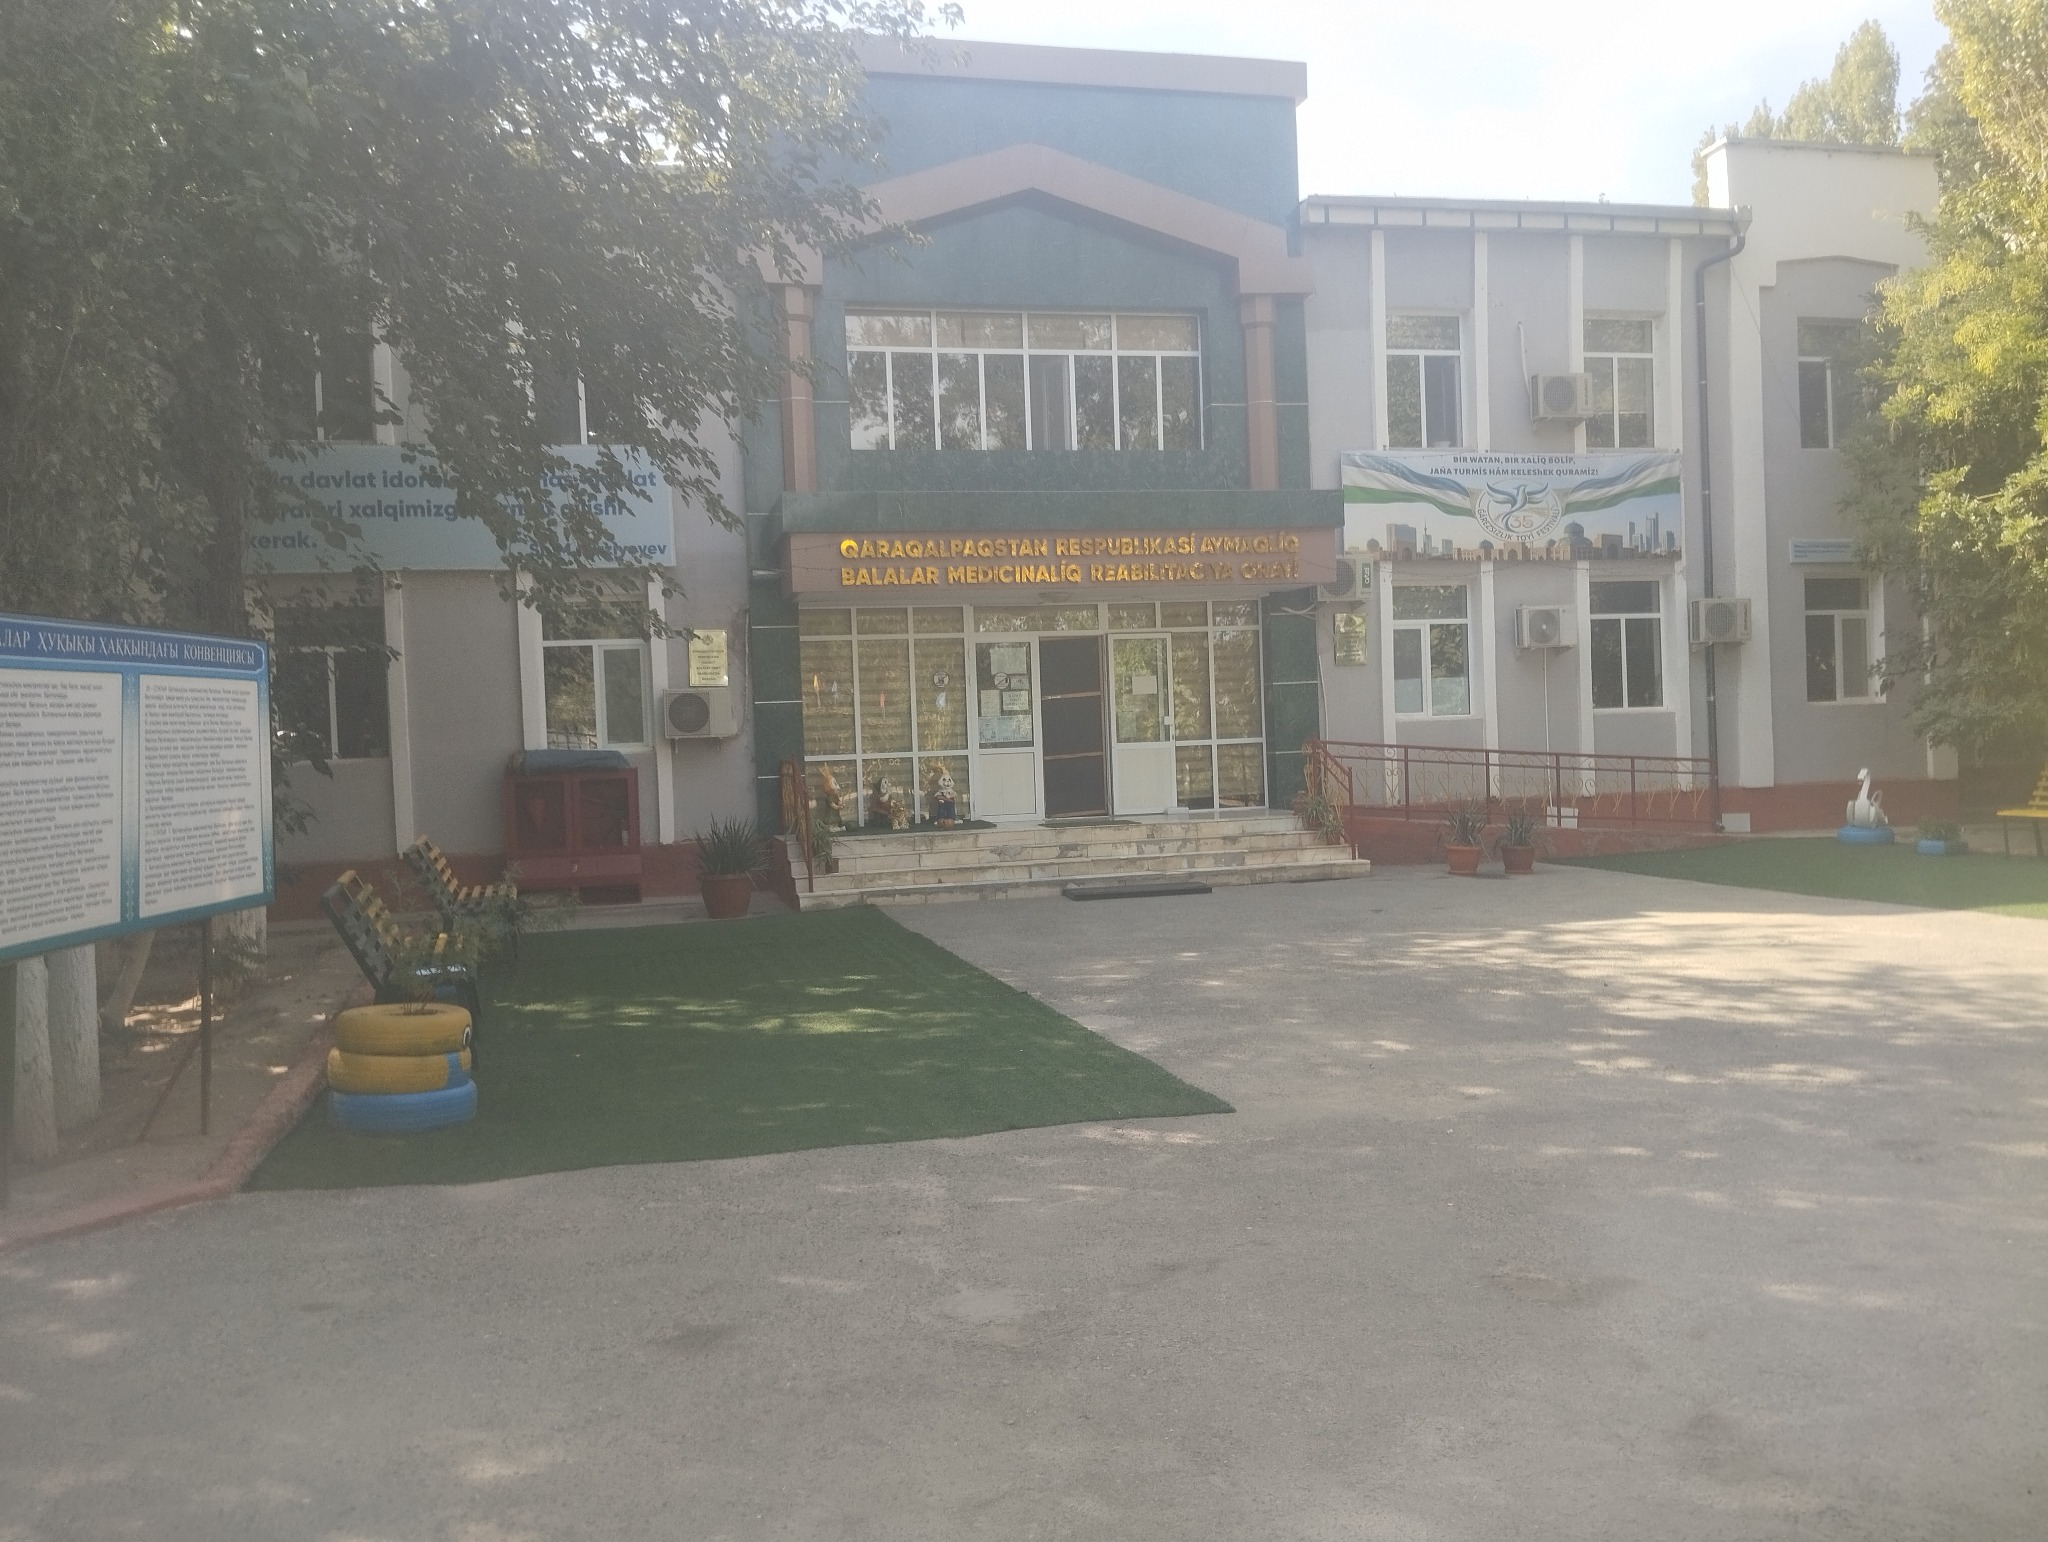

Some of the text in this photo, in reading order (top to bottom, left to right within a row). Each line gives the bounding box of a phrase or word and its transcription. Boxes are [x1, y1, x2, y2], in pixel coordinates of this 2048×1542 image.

[1452, 455, 1468, 464] BIR
[1504, 456, 1519, 465] BIR
[301, 471, 376, 488] davlat
[840, 538, 1048, 558] QARAQALPAQSTAN
[841, 566, 940, 586] BALALAR
[0, 627, 31, 650] ЛАР
